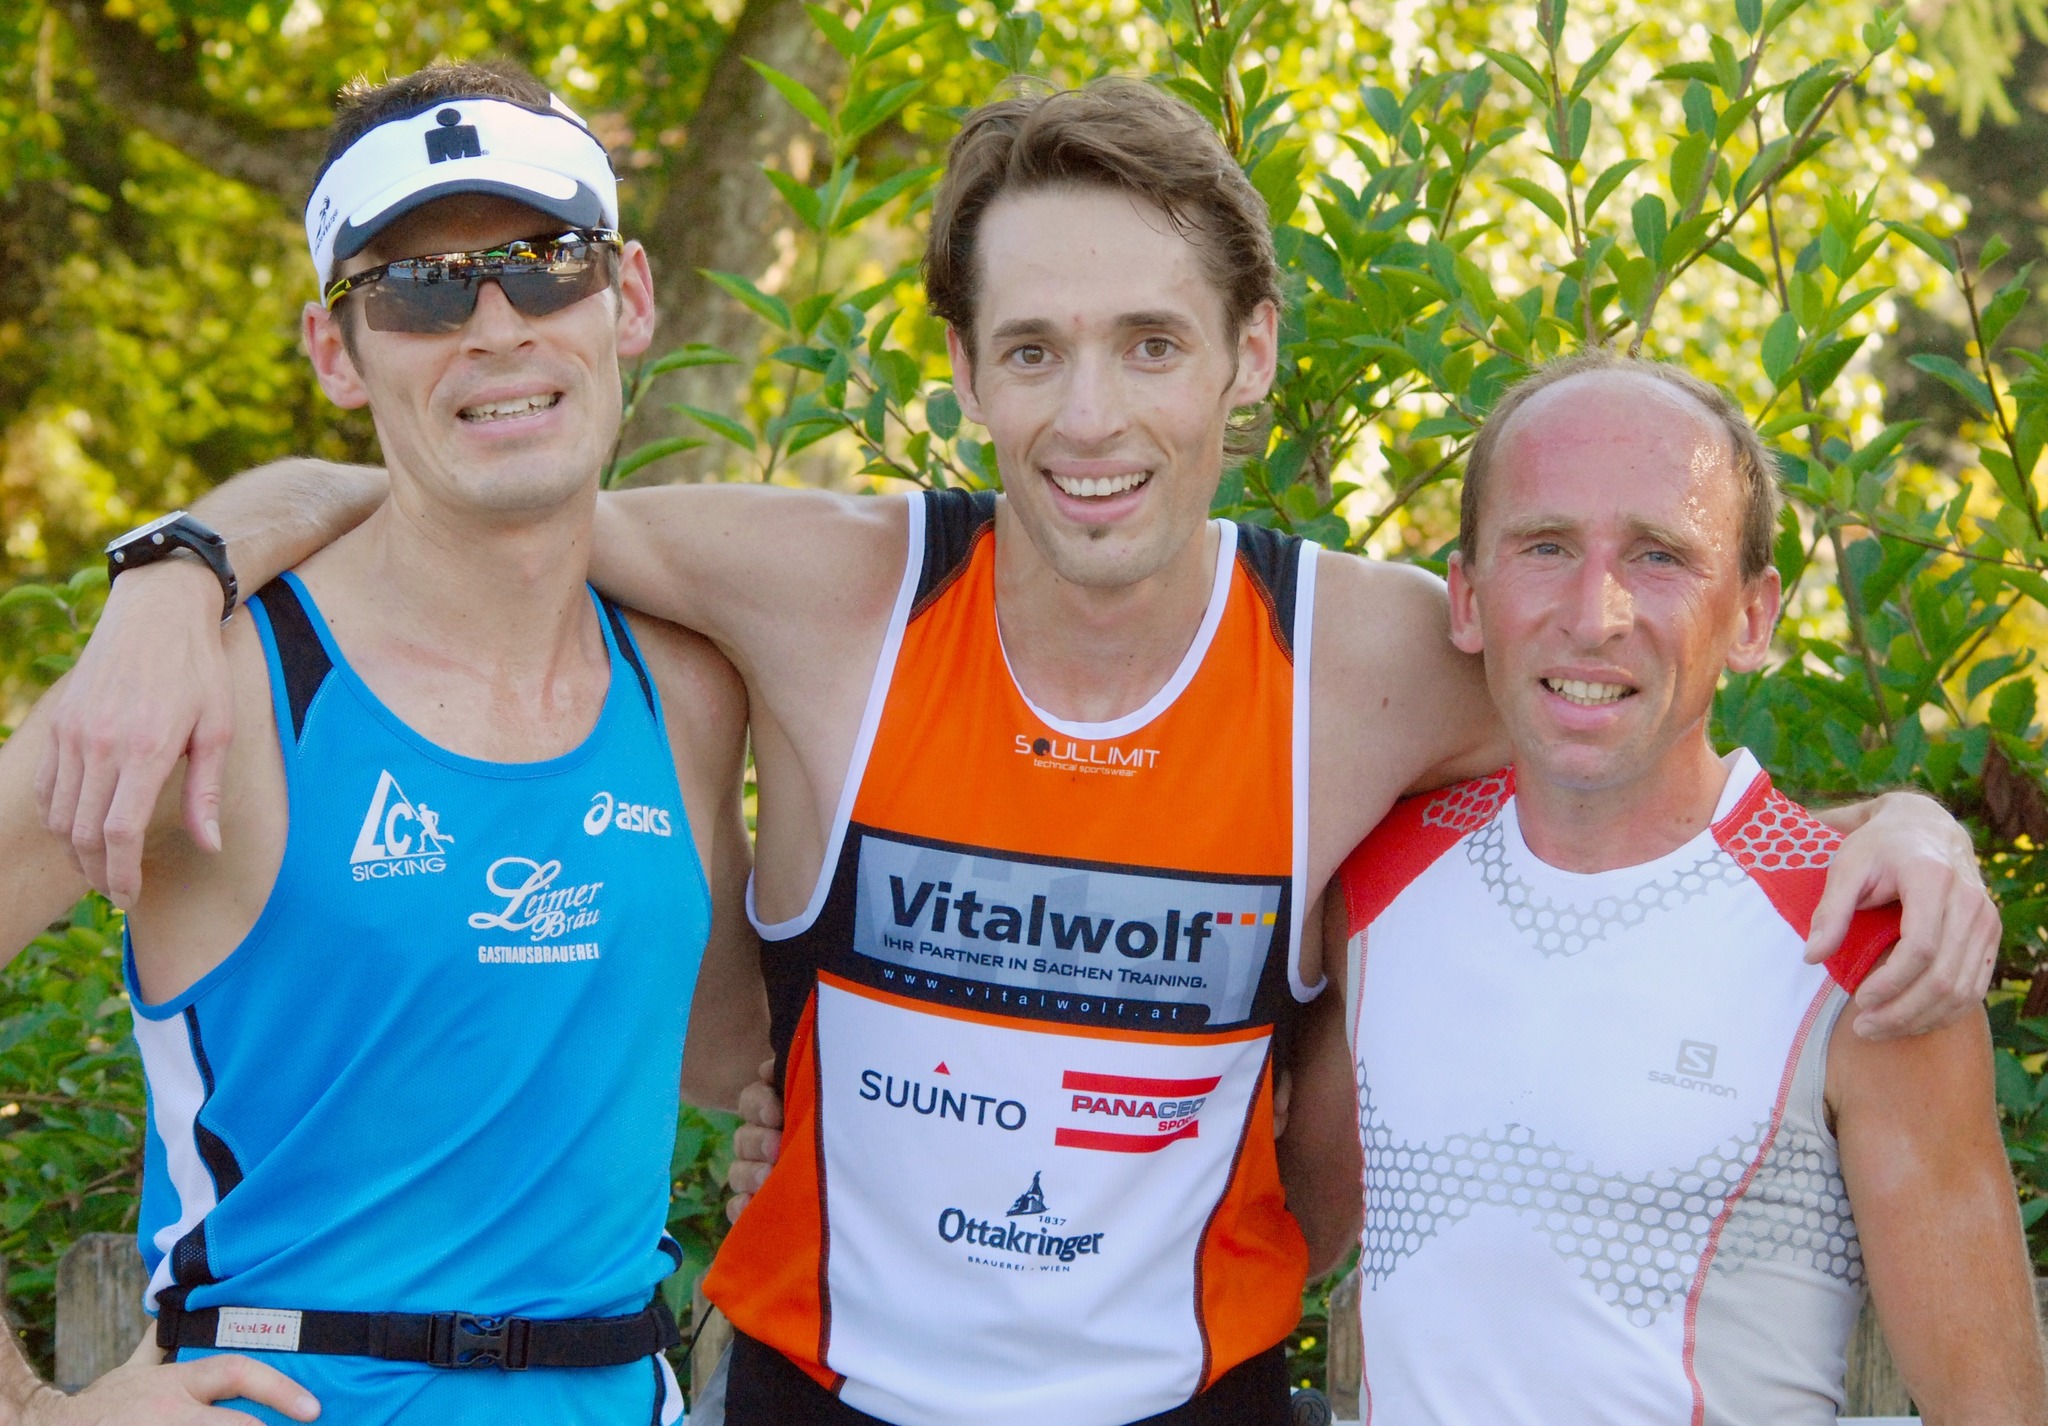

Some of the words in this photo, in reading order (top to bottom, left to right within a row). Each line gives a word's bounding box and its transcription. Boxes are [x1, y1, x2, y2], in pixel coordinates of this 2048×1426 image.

[1033, 758, 1078, 772] technical
[1078, 765, 1138, 777] sportswear
[615, 802, 671, 837] asics
[352, 857, 447, 882] SICKING
[468, 856, 604, 931] Leimer
[530, 908, 600, 941] Bräu
[889, 875, 1214, 963] Vitalwolf
[478, 941, 600, 964] GASTHAUSBRAUEREI
[884, 934, 914, 953] IHR
[919, 941, 1004, 969] PARTNER
[1008, 957, 1028, 972] IN
[1032, 958, 1113, 982] SACHEN
[1117, 968, 1208, 990] TRAINING.
[883, 968, 1178, 1020] www.vitalwolf.at
[859, 1069, 1027, 1131] SUUNTO
[1648, 1070, 1738, 1100] salomon
[938, 1207, 1105, 1263] Ottakringer
[1038, 1215, 1067, 1227] 1837
[967, 1255, 1025, 1272] BRAUEREI
[1040, 1264, 1071, 1273] WIEN
